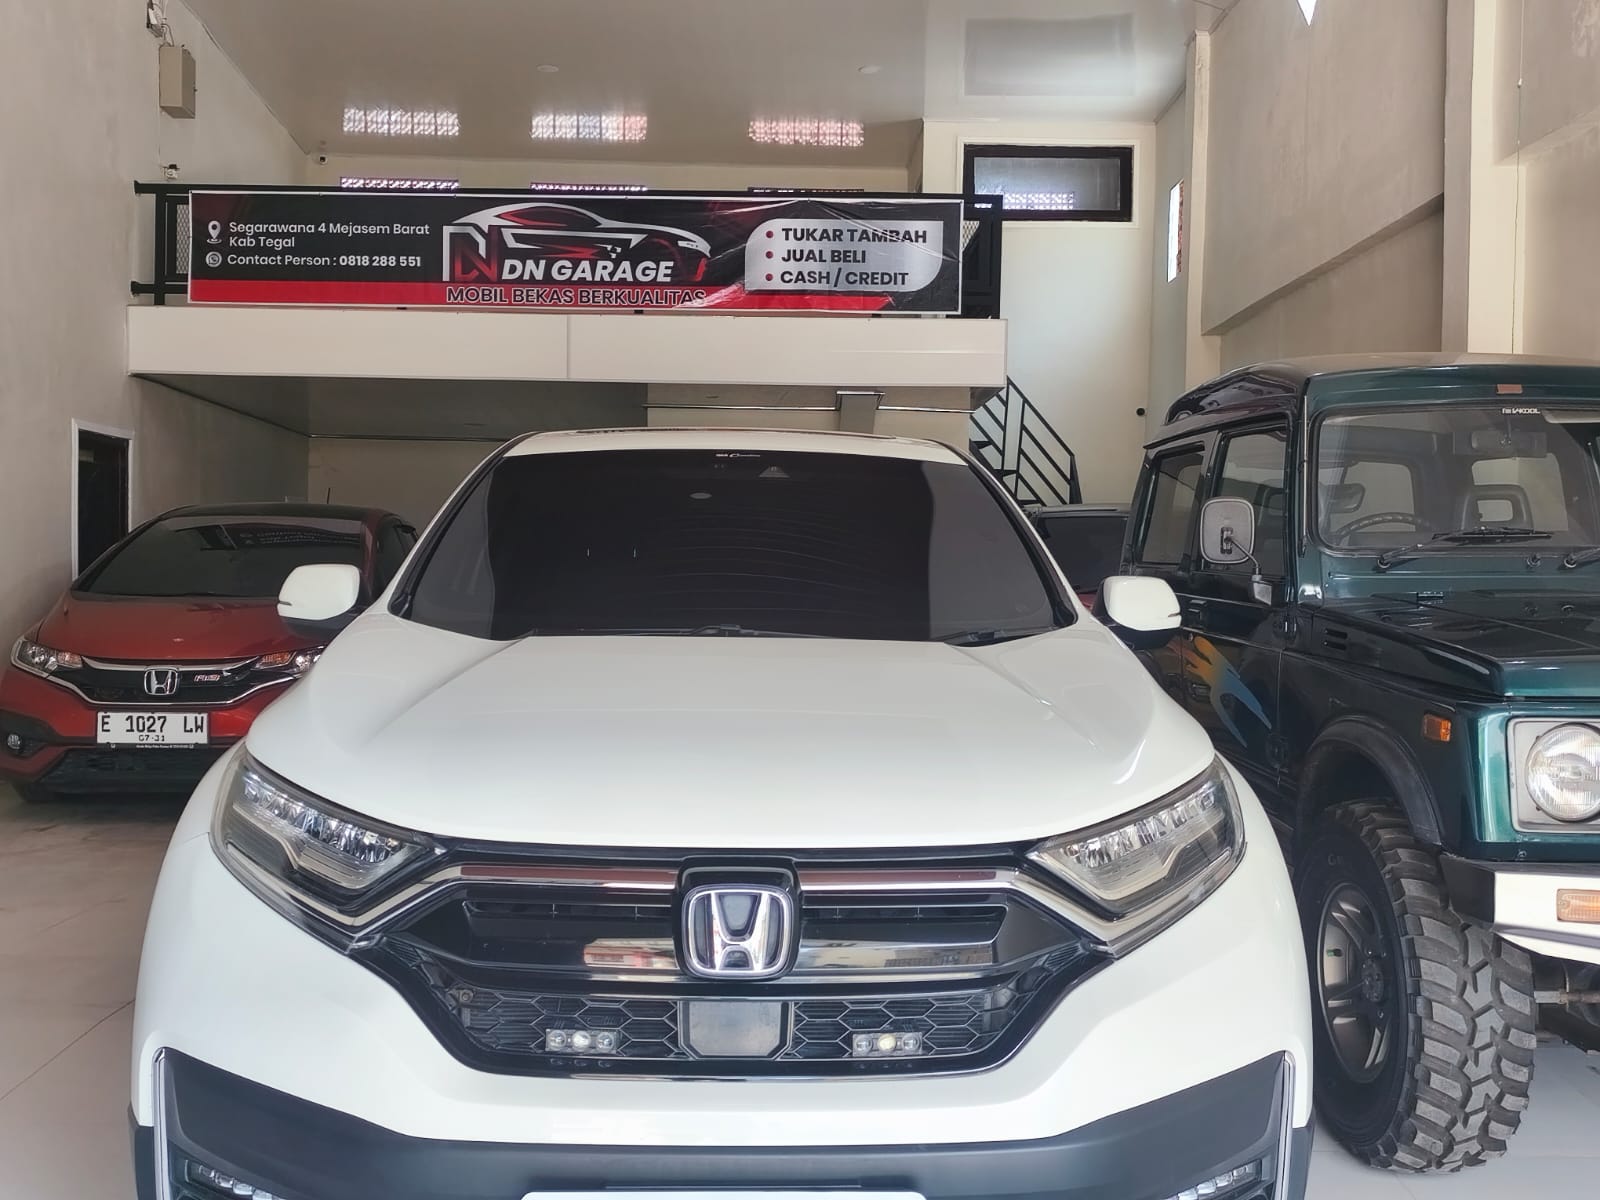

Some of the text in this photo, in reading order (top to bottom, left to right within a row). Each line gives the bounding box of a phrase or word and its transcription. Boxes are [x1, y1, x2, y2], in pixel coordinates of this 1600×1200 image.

[229, 222, 430, 236] Segarawana 4 Mejasem Barat
[781, 228, 927, 244] TUKAR TAMBAH
[229, 236, 295, 250] Kab Tegal
[227, 254, 282, 266] Contact
[284, 255, 330, 266] Person
[339, 255, 370, 267] 0818
[372, 256, 397, 267] 288
[399, 256, 422, 267] 551
[781, 249, 866, 263] JUAL BELI
[501, 259, 675, 282] DN GARAGE
[780, 270, 831, 284] CASH
[845, 271, 909, 286] CREDIT
[446, 286, 706, 306] MOBIL BEKAS BERKUALITAS
[101, 715, 204, 733] E 1027 LW
